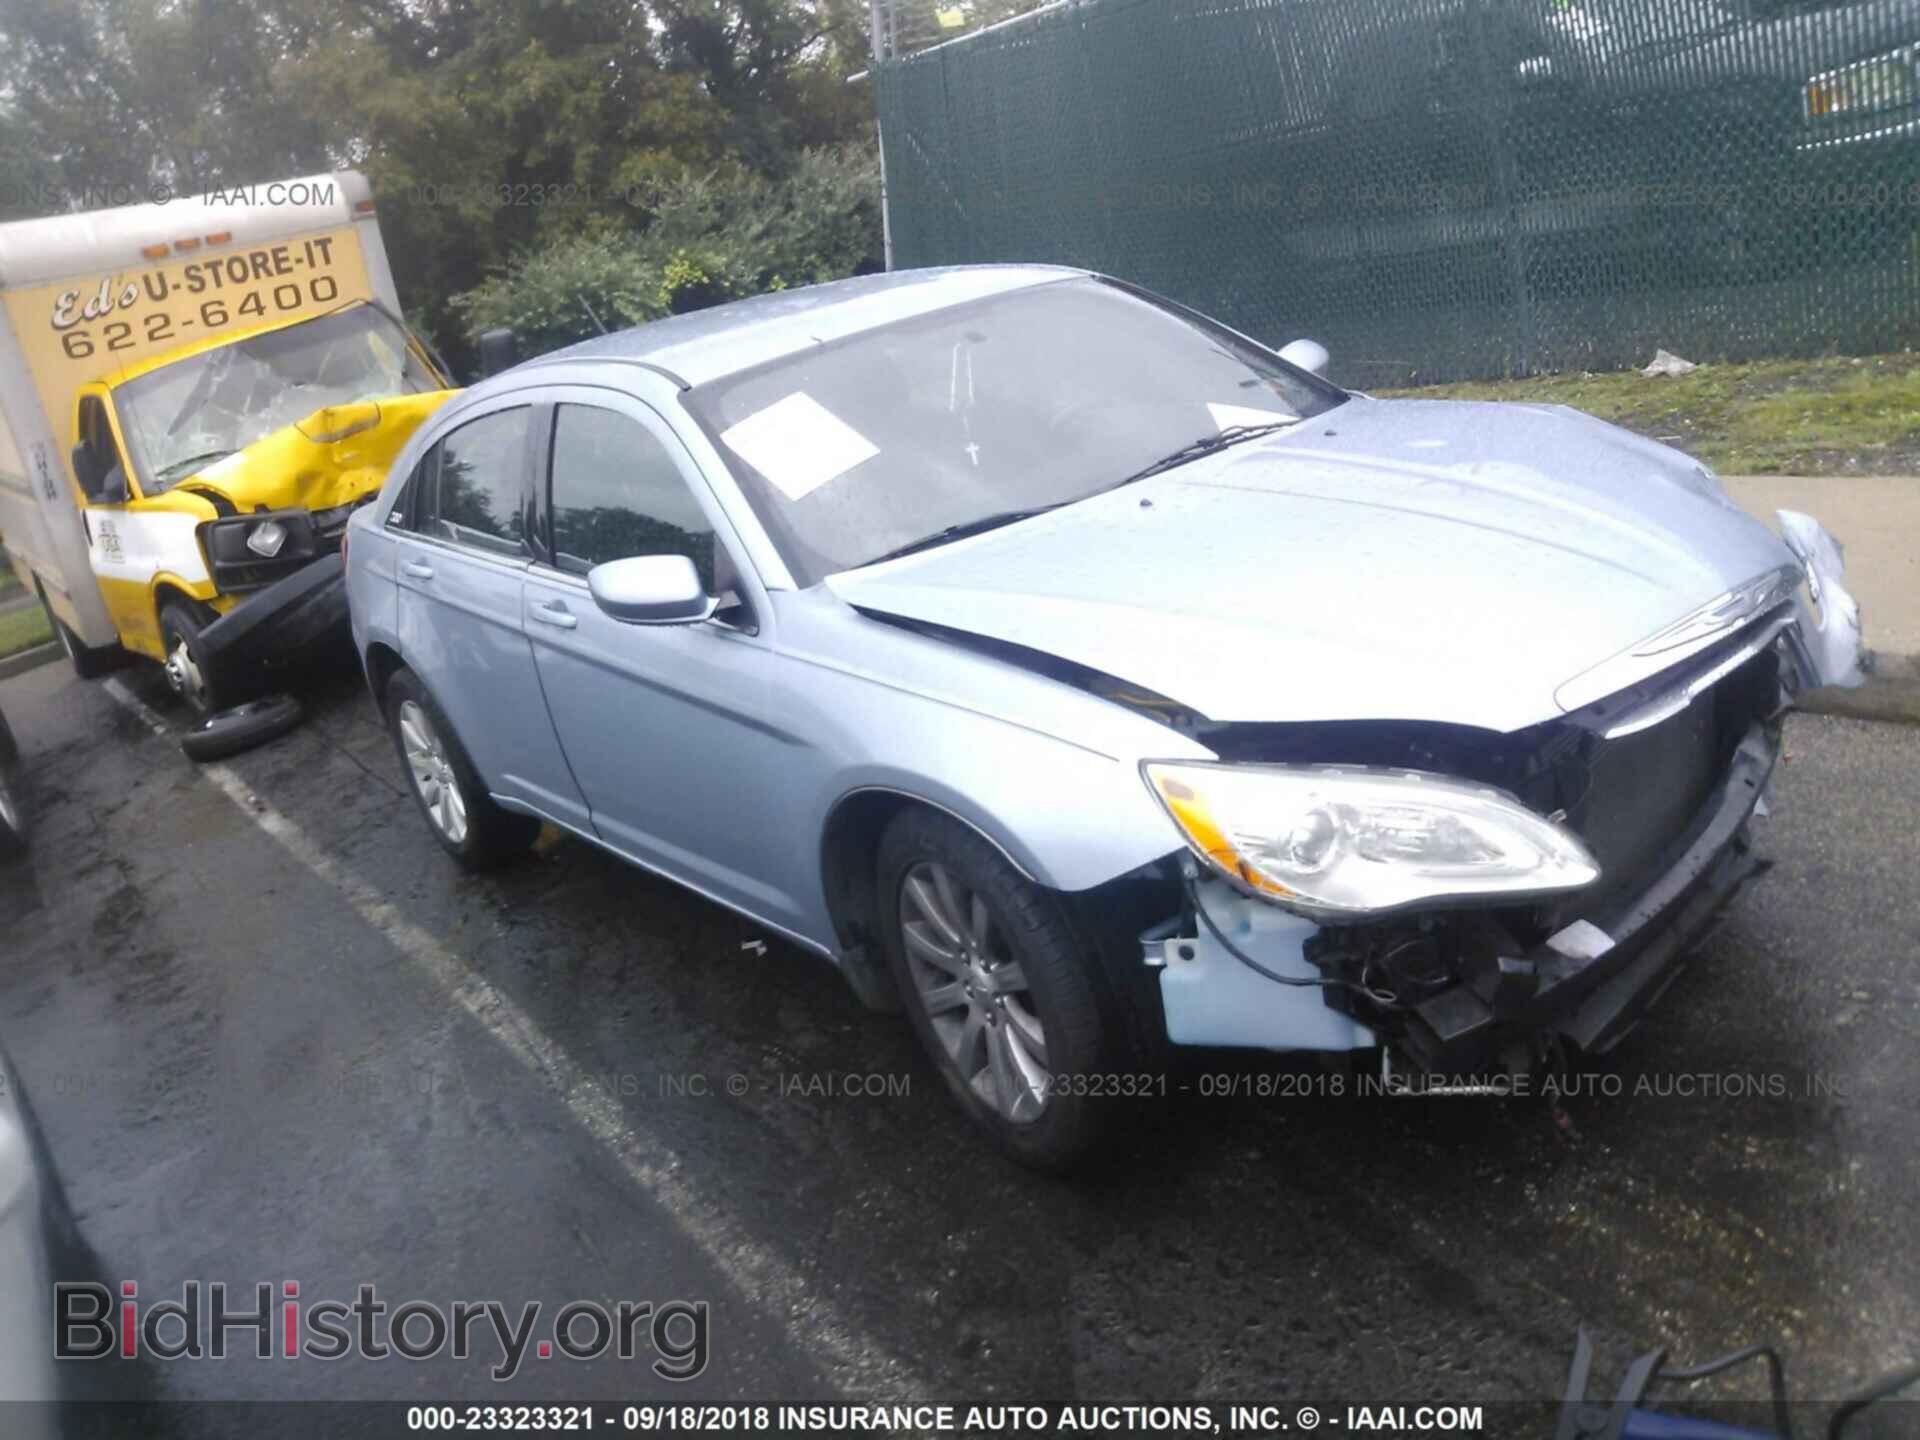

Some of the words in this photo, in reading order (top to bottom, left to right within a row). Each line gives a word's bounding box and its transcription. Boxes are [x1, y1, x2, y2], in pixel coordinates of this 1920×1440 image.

[51, 272, 138, 329] Ed's
[142, 237, 332, 300] U-STORE-IT
[62, 276, 338, 359] 622-6400
